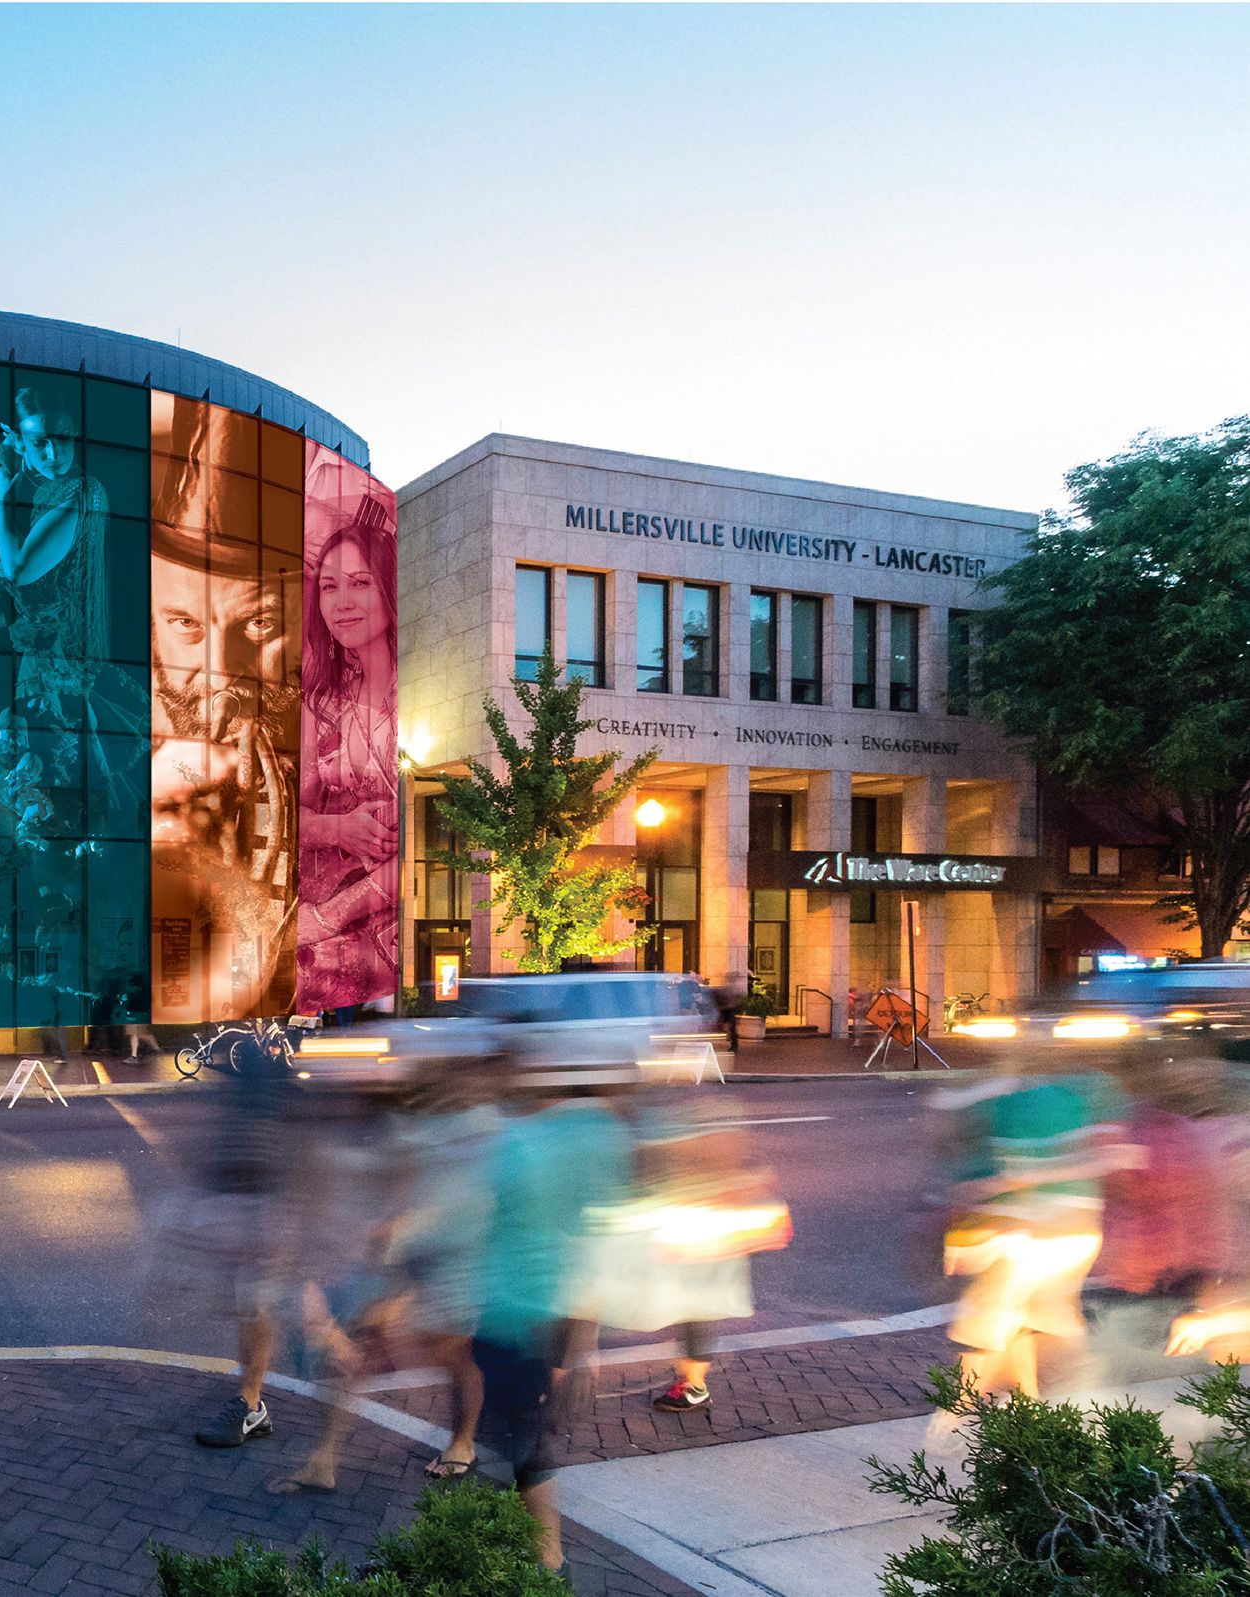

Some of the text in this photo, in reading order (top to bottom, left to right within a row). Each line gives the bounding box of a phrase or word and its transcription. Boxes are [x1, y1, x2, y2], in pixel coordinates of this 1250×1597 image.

[565, 504, 724, 547] MILLERSVILLE
[732, 526, 856, 562] UNIVERSITY
[875, 545, 986, 578] LANCASTER
[597, 718, 960, 755] CREATIVITY INNOVATION ENGAGEMENT
[846, 857, 1007, 883] The Ware Center
